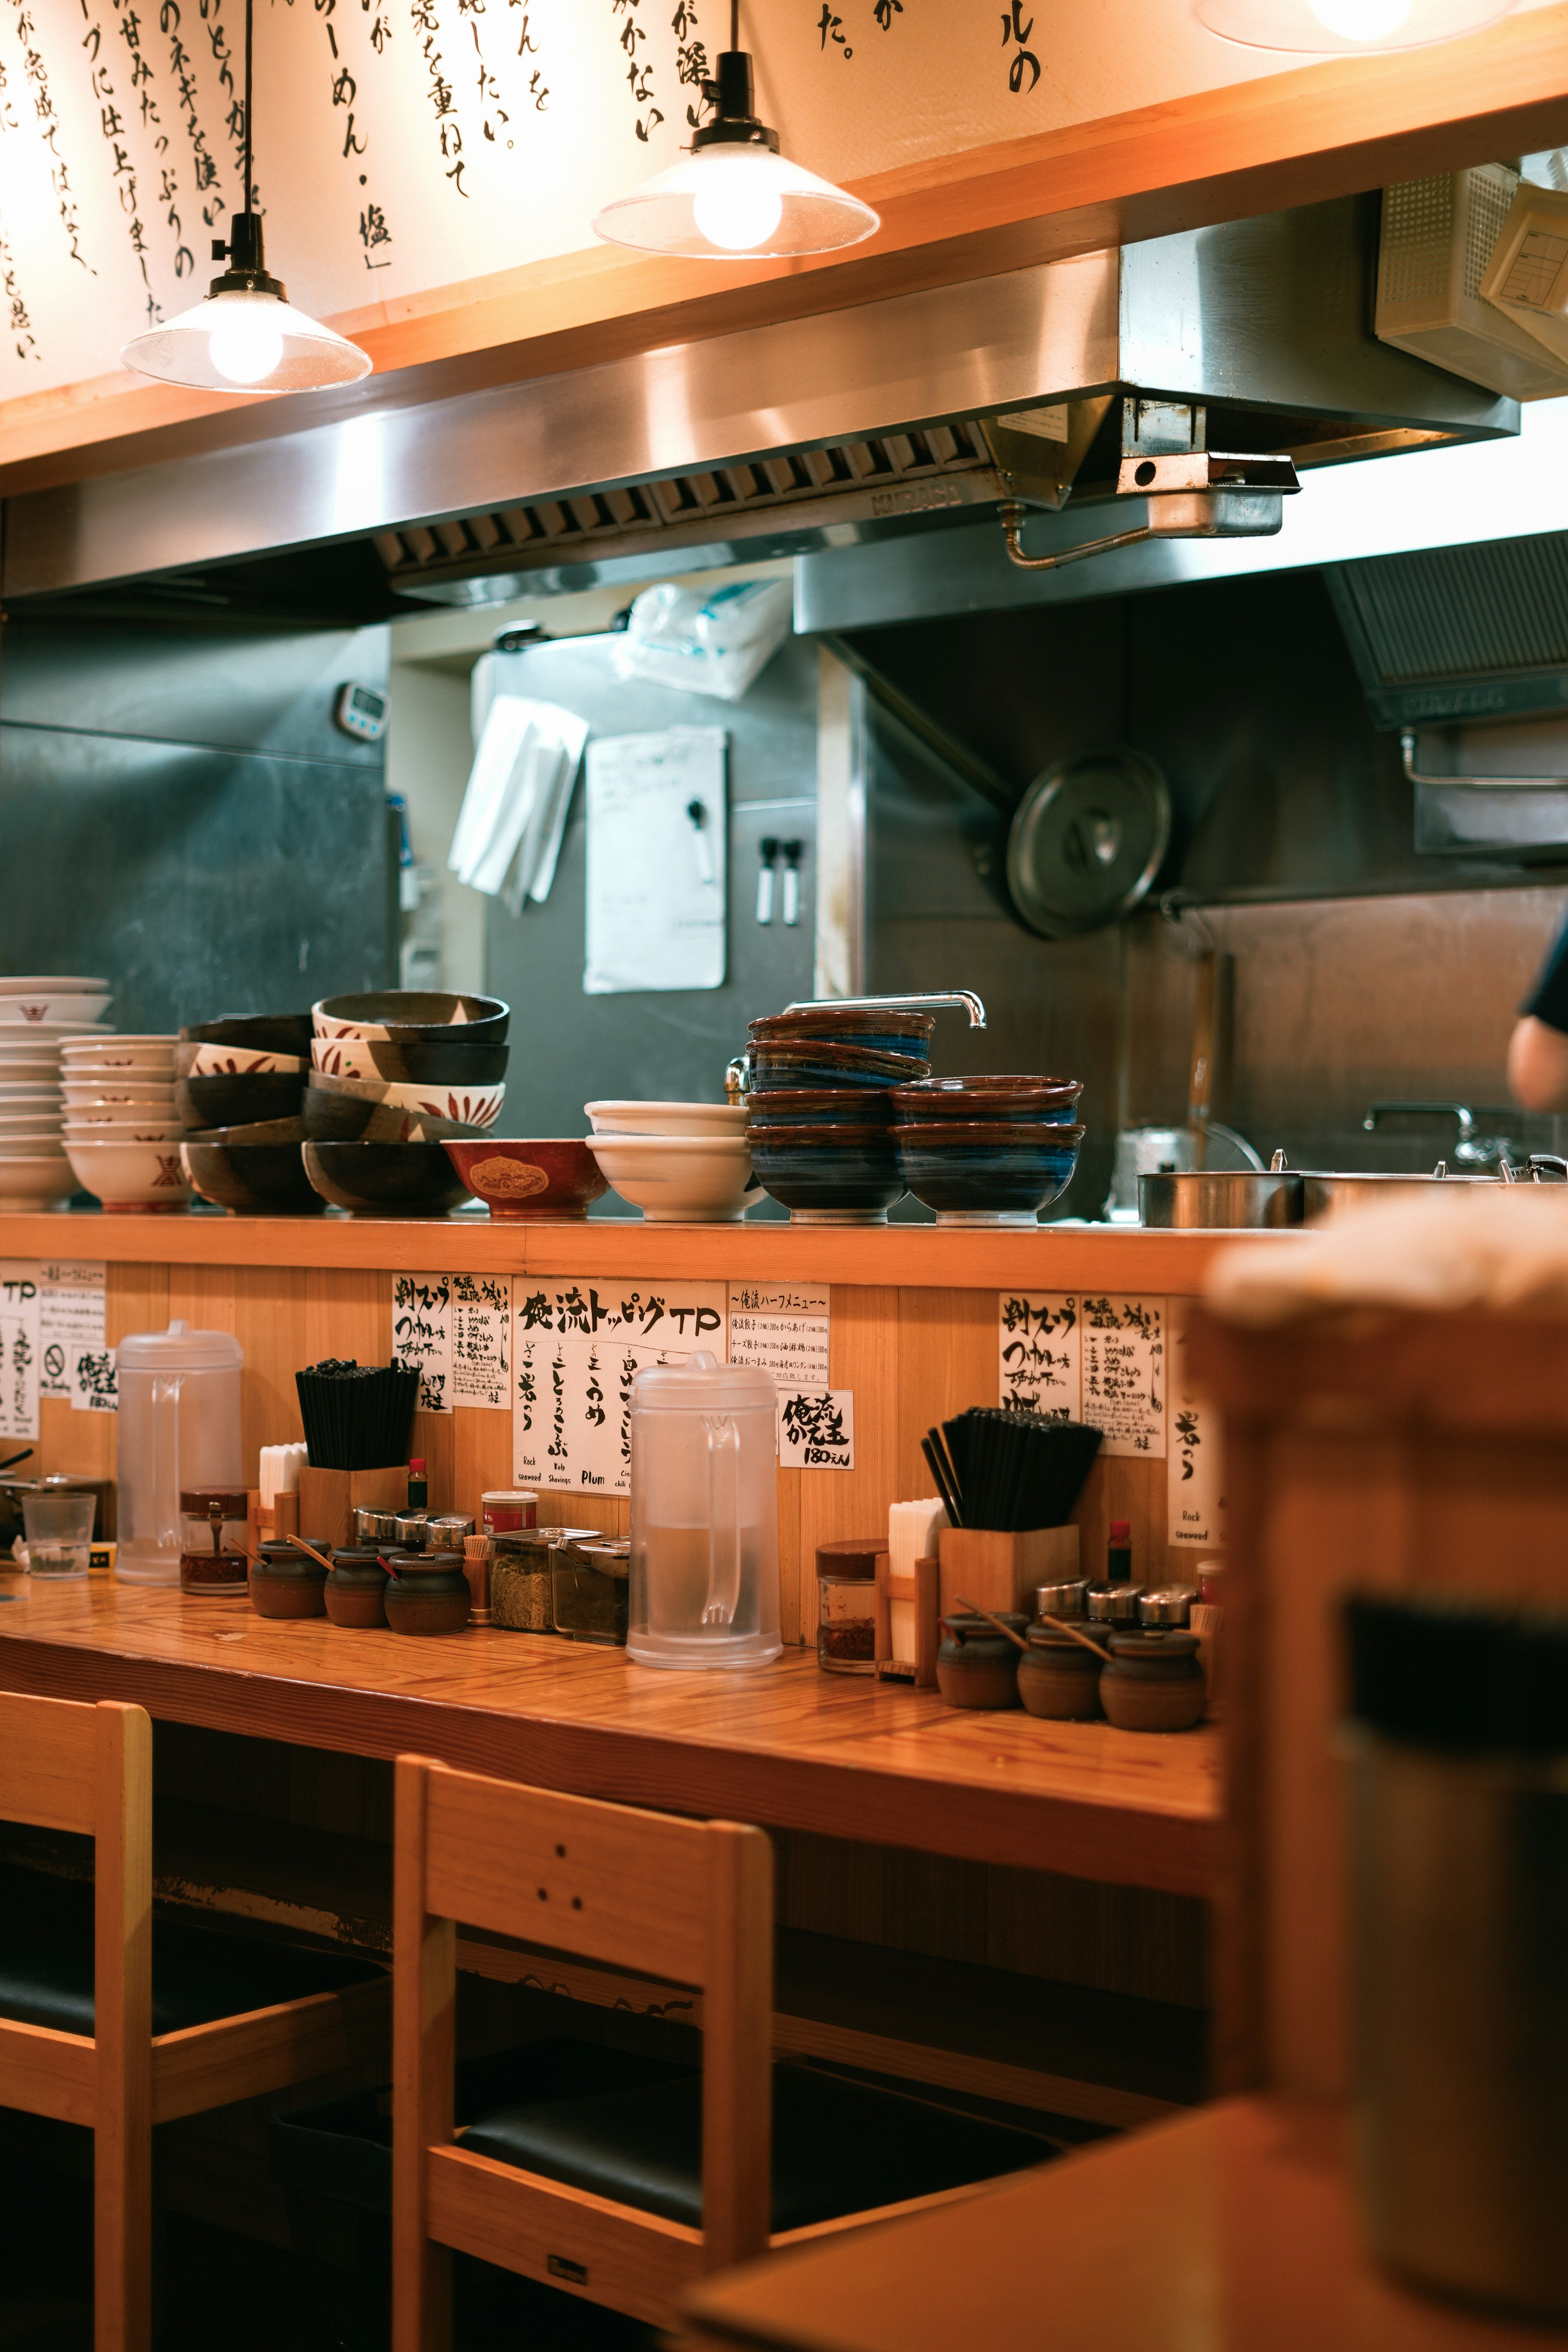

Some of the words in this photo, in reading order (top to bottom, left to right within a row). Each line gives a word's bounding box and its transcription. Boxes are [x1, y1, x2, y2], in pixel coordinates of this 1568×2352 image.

[817, 3, 853, 59] た。
[509, 0, 549, 111] んを
[7, 0, 98, 276] が完成ではなく、
[112, 0, 195, 279] 甘みたっぷりの
[3, 1281, 36, 1303] TP
[394, 1276, 449, 1314] 割スープ
[1002, 1297, 1076, 1339] 割スープ
[523, 1456, 536, 1466] Rock
[554, 1462, 565, 1472] Kelp
[518, 1473, 541, 1481] seaweed
[548, 1474, 571, 1484] Shavings
[581, 1470, 605, 1485] Plum
[1182, 1510, 1200, 1522] Rock
[1175, 1530, 1208, 1541] seaweed
